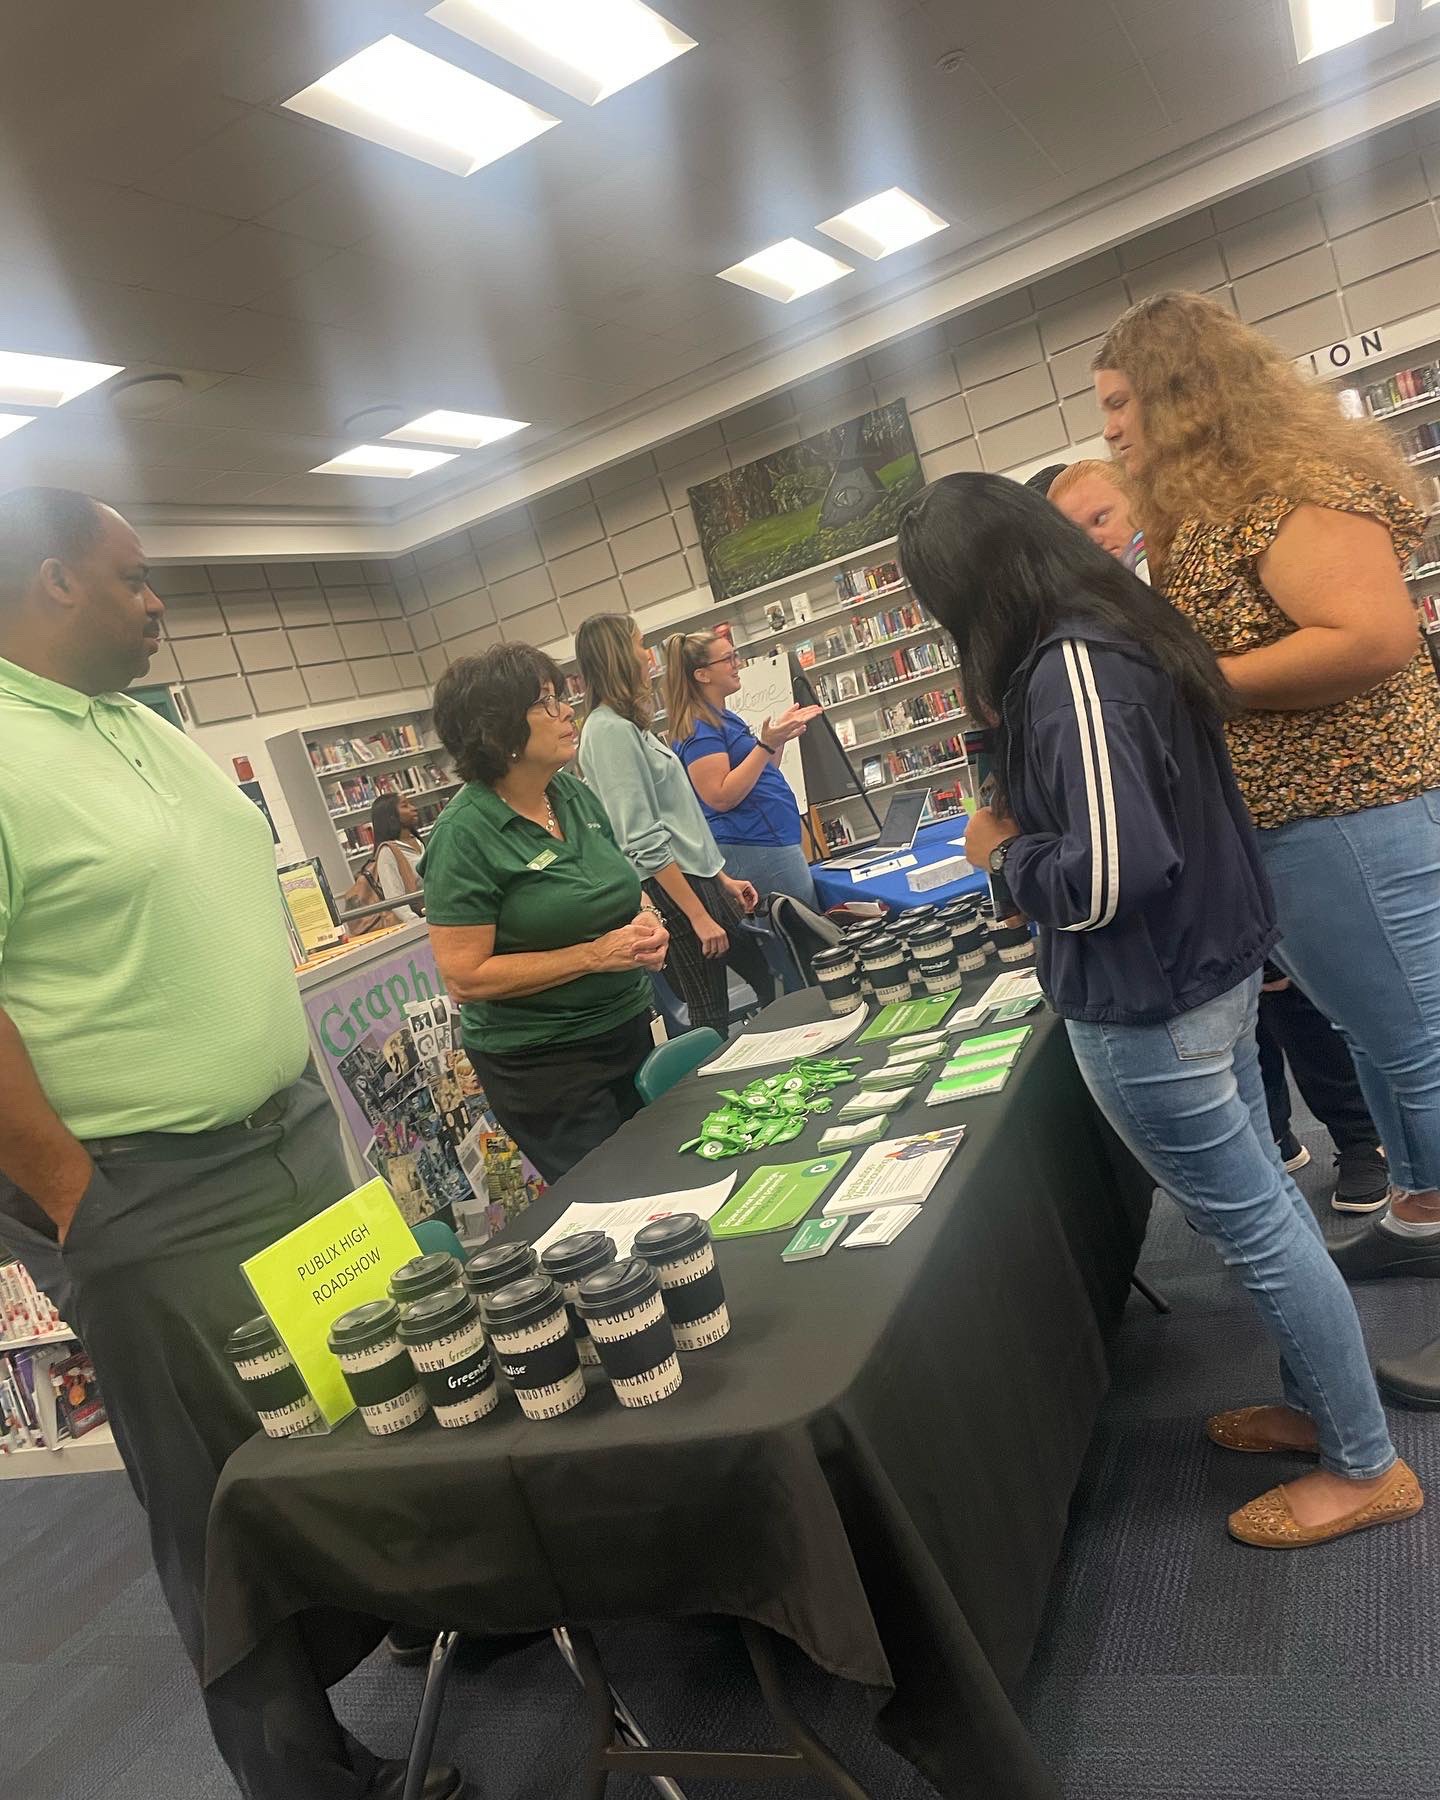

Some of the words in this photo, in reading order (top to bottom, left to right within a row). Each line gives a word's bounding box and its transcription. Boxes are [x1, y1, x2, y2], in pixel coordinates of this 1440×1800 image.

[297, 1243, 341, 1281] PUBLIX
[339, 1223, 371, 1252] HIGH
[312, 1247, 381, 1305] ROADSHOW
[696, 1328, 726, 1347] SINGLE
[262, 1348, 289, 1363] COL
[419, 1358, 446, 1374] BREW
[280, 1414, 312, 1436] SINGLE
[382, 1413, 412, 1434] BLEND
